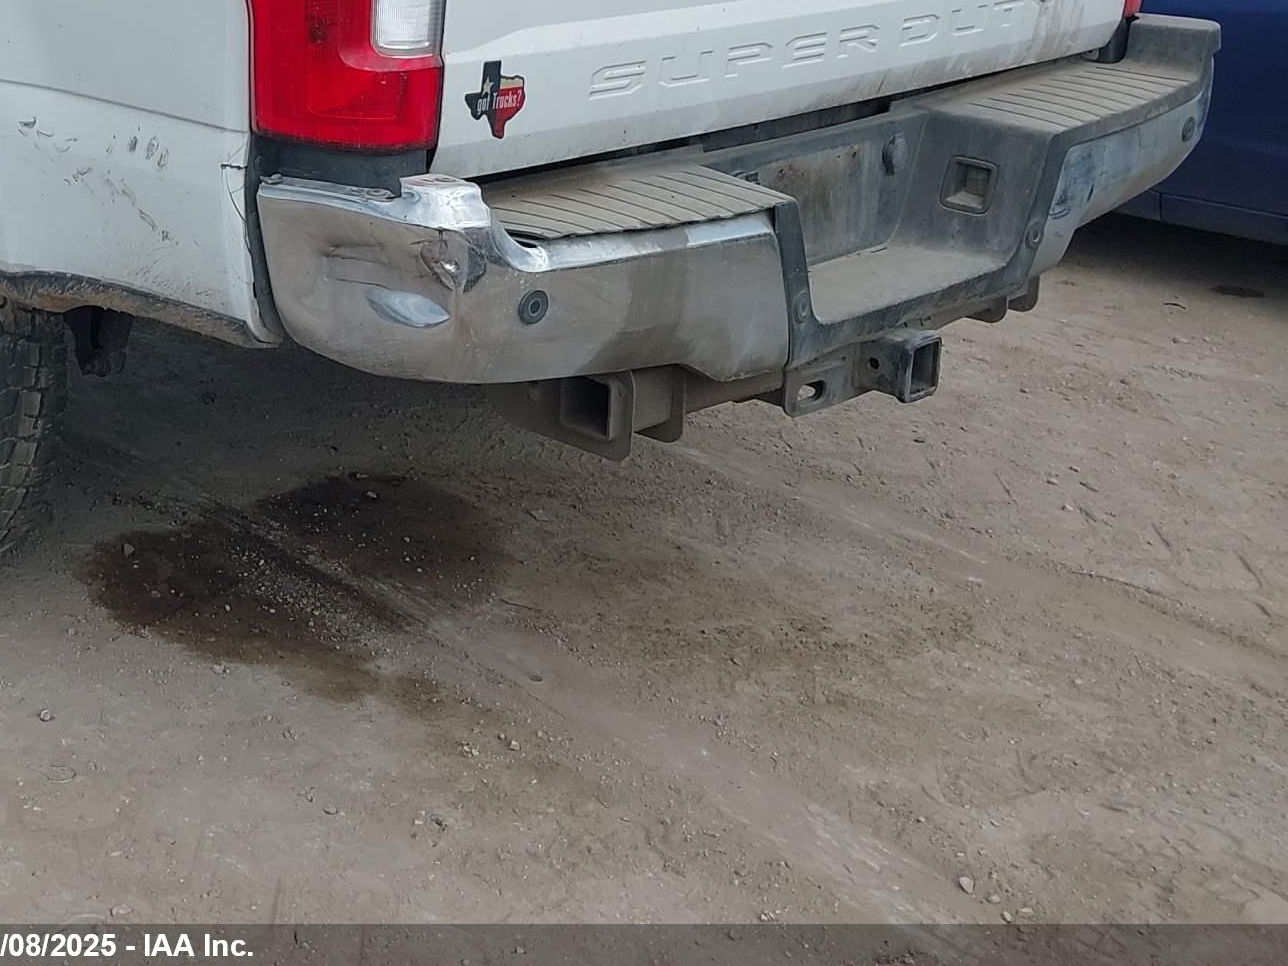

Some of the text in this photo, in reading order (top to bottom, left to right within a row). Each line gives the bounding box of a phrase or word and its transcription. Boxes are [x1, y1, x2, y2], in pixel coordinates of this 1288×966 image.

[587, 23, 880, 100] SUPER
[476, 90, 522, 116] got Trucks?
